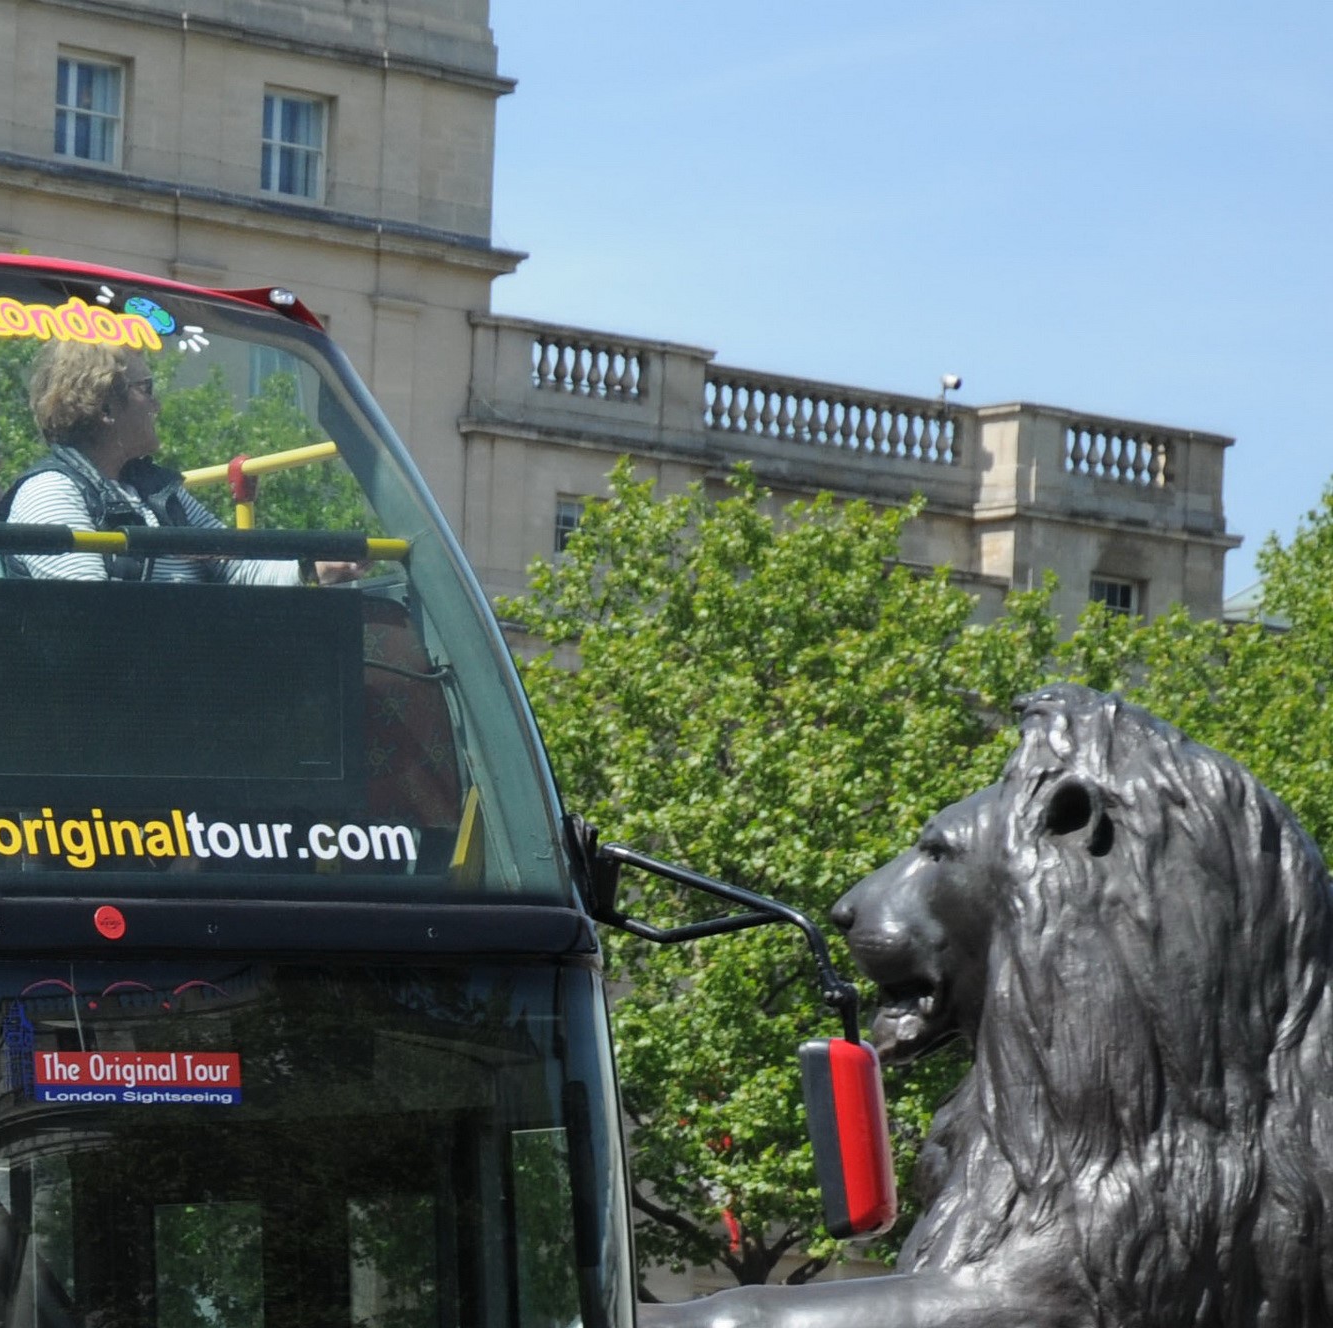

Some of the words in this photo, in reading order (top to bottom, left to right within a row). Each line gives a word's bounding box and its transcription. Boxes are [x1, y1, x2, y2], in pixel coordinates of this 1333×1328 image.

[43, 1052, 81, 1081] The
[89, 1052, 177, 1088] Original
[184, 1054, 230, 1082] Tour
[44, 1091, 117, 1102] London
[122, 1091, 233, 1104] Sightseeing
